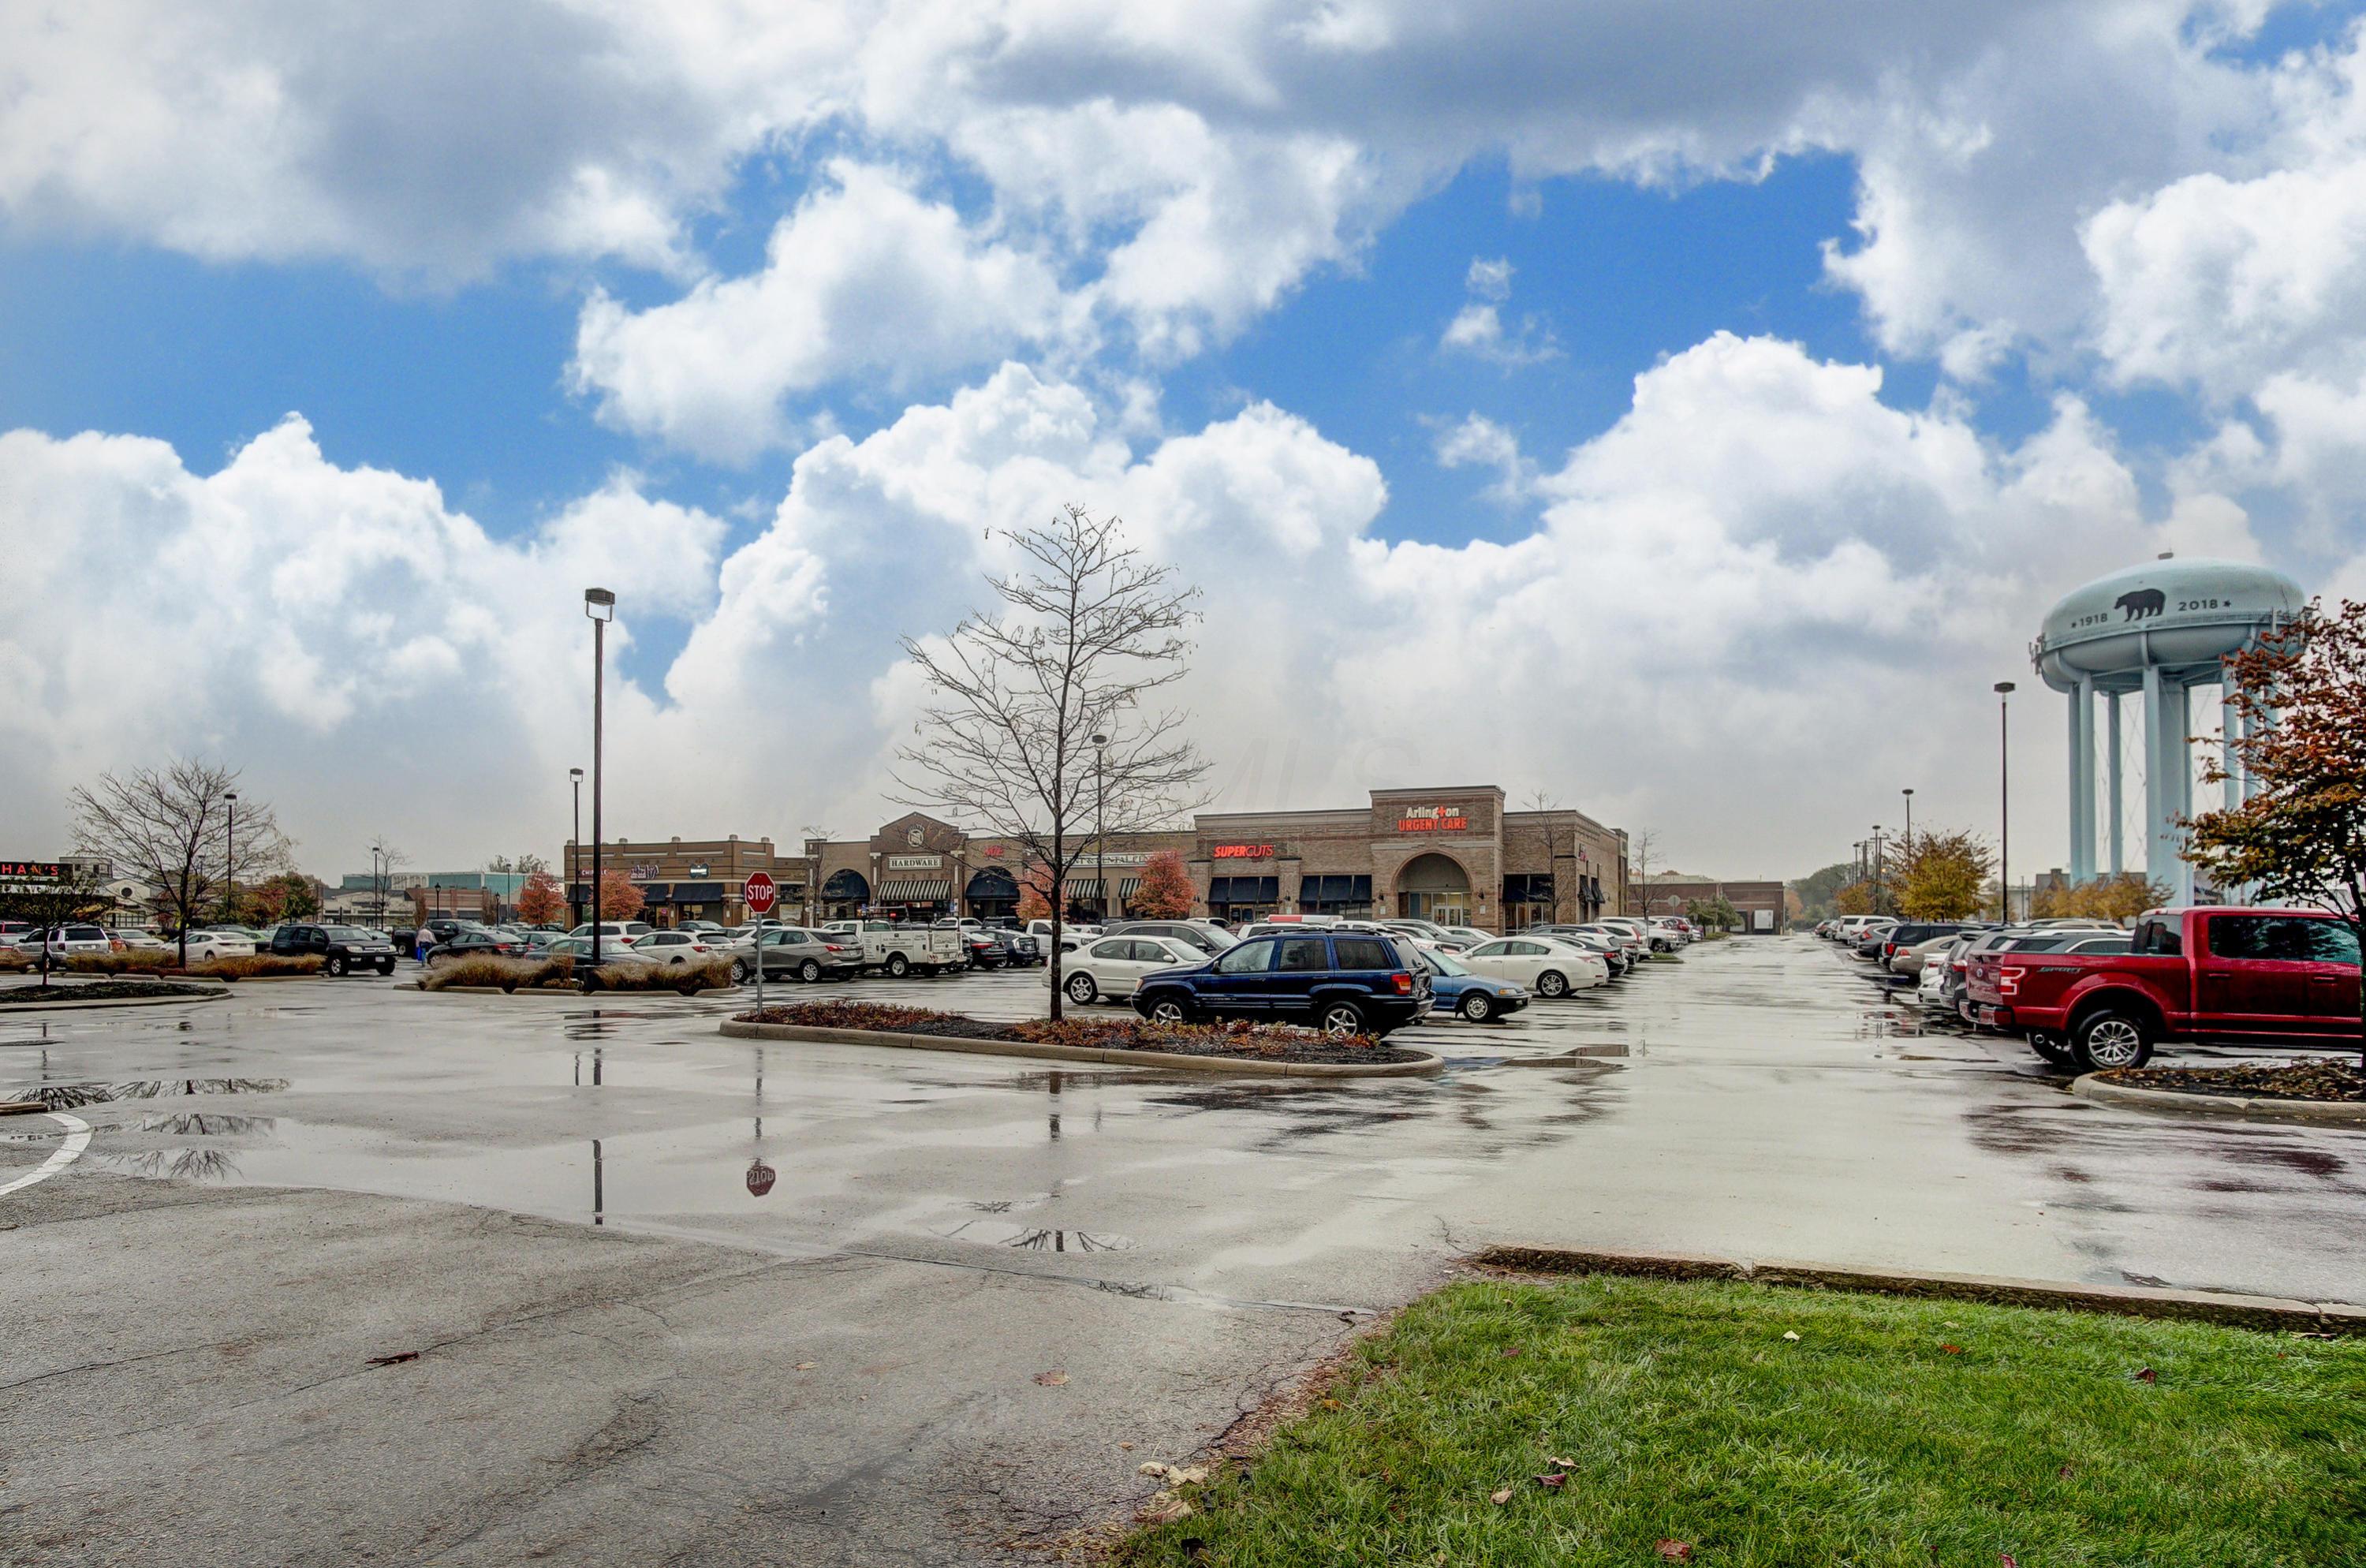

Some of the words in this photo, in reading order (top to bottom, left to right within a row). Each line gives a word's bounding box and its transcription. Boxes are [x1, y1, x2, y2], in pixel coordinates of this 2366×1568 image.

[2080, 613, 2107, 626] 1918
[2178, 599, 2218, 611] 2018
[1405, 806, 1459, 819] Arlington
[1398, 819, 1438, 831] URGENT
[1440, 817, 1467, 830] CARE
[1214, 845, 1274, 857] SUPERCUTS
[748, 885, 773, 900] STOP
